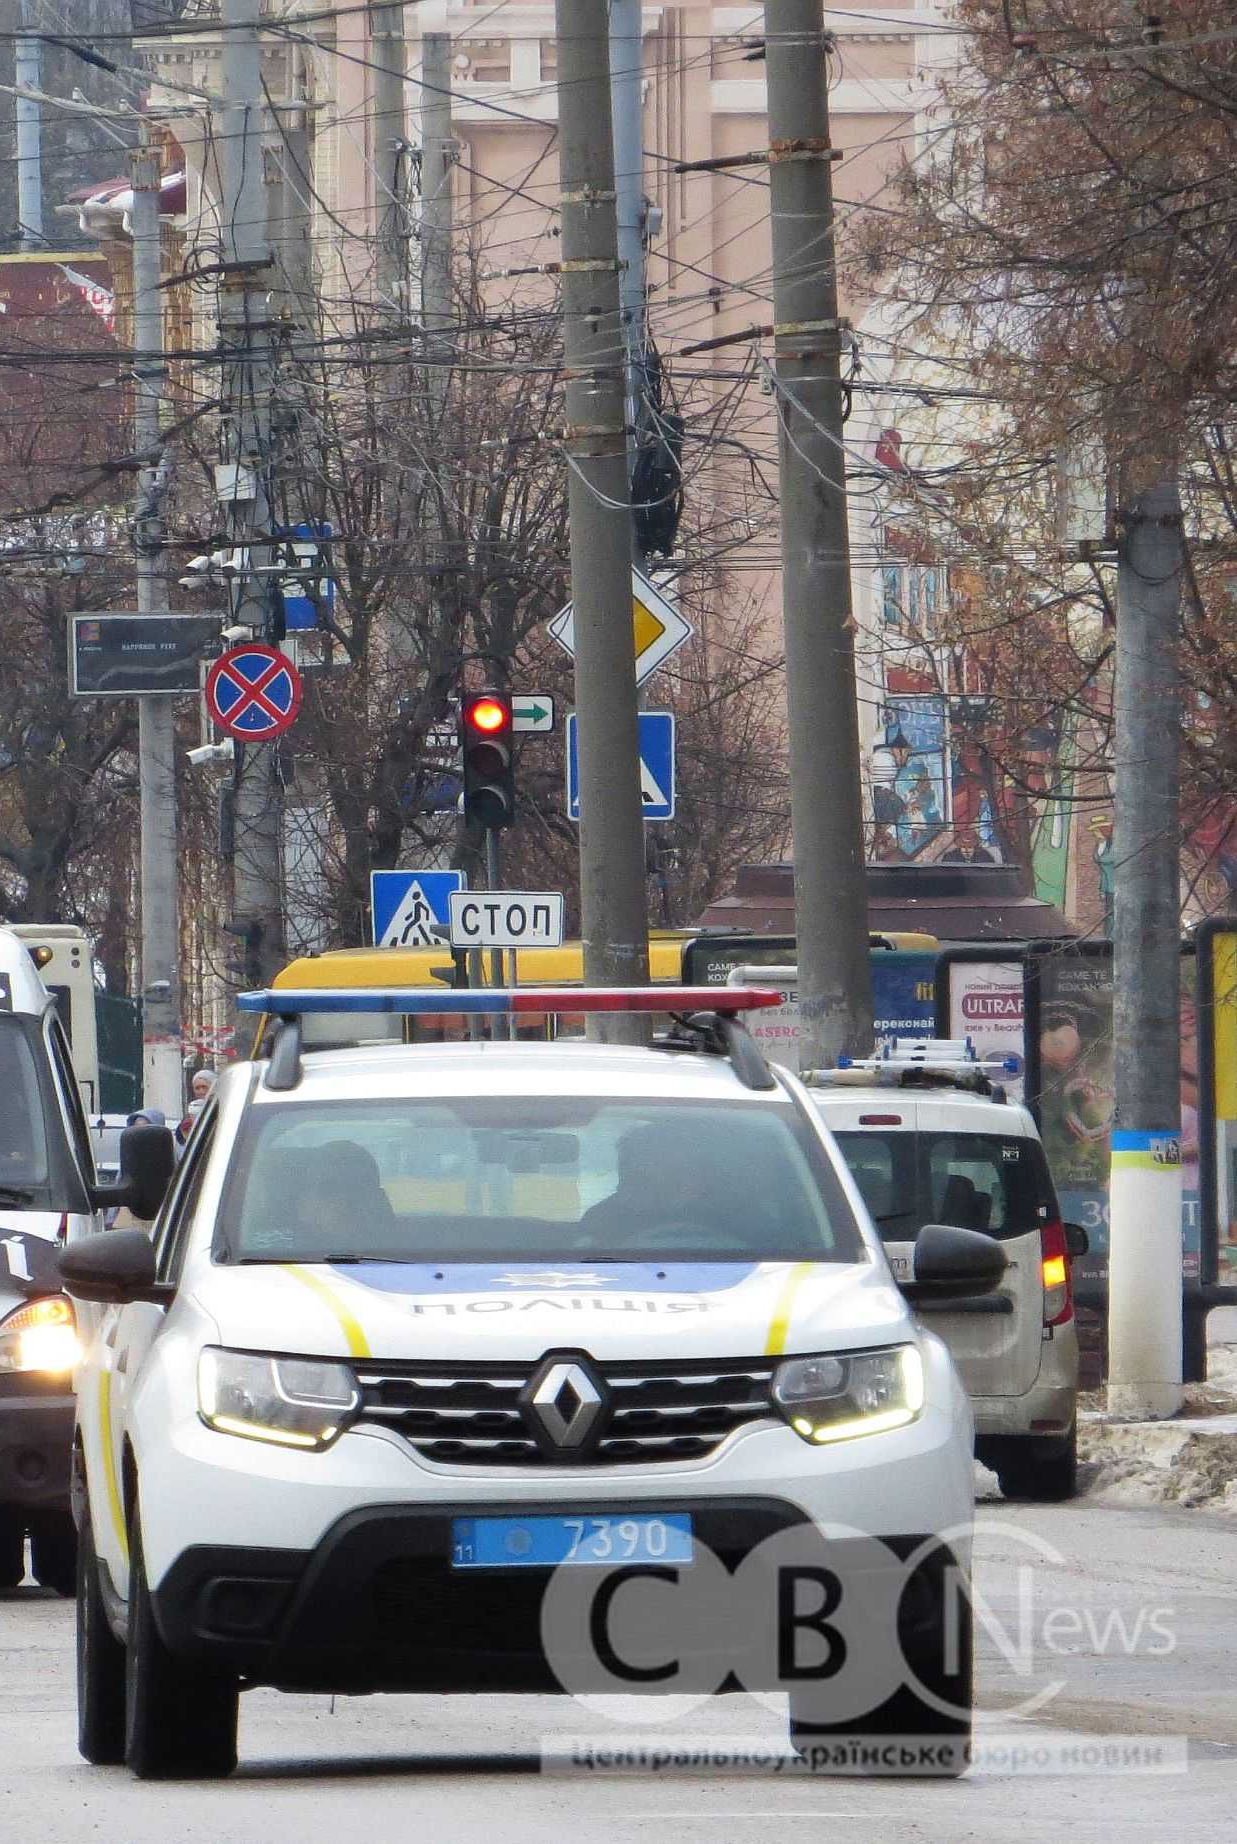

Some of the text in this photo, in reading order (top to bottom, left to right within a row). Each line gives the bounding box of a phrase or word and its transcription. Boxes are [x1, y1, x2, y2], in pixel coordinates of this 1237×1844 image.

[462, 903, 550, 936] СТОП
[967, 999, 1025, 1013] ULTRAF
[874, 1018, 934, 1030] ереконай
[411, 1298, 710, 1316] ПОЛІЦІЯ
[563, 1519, 667, 1558] 7390
